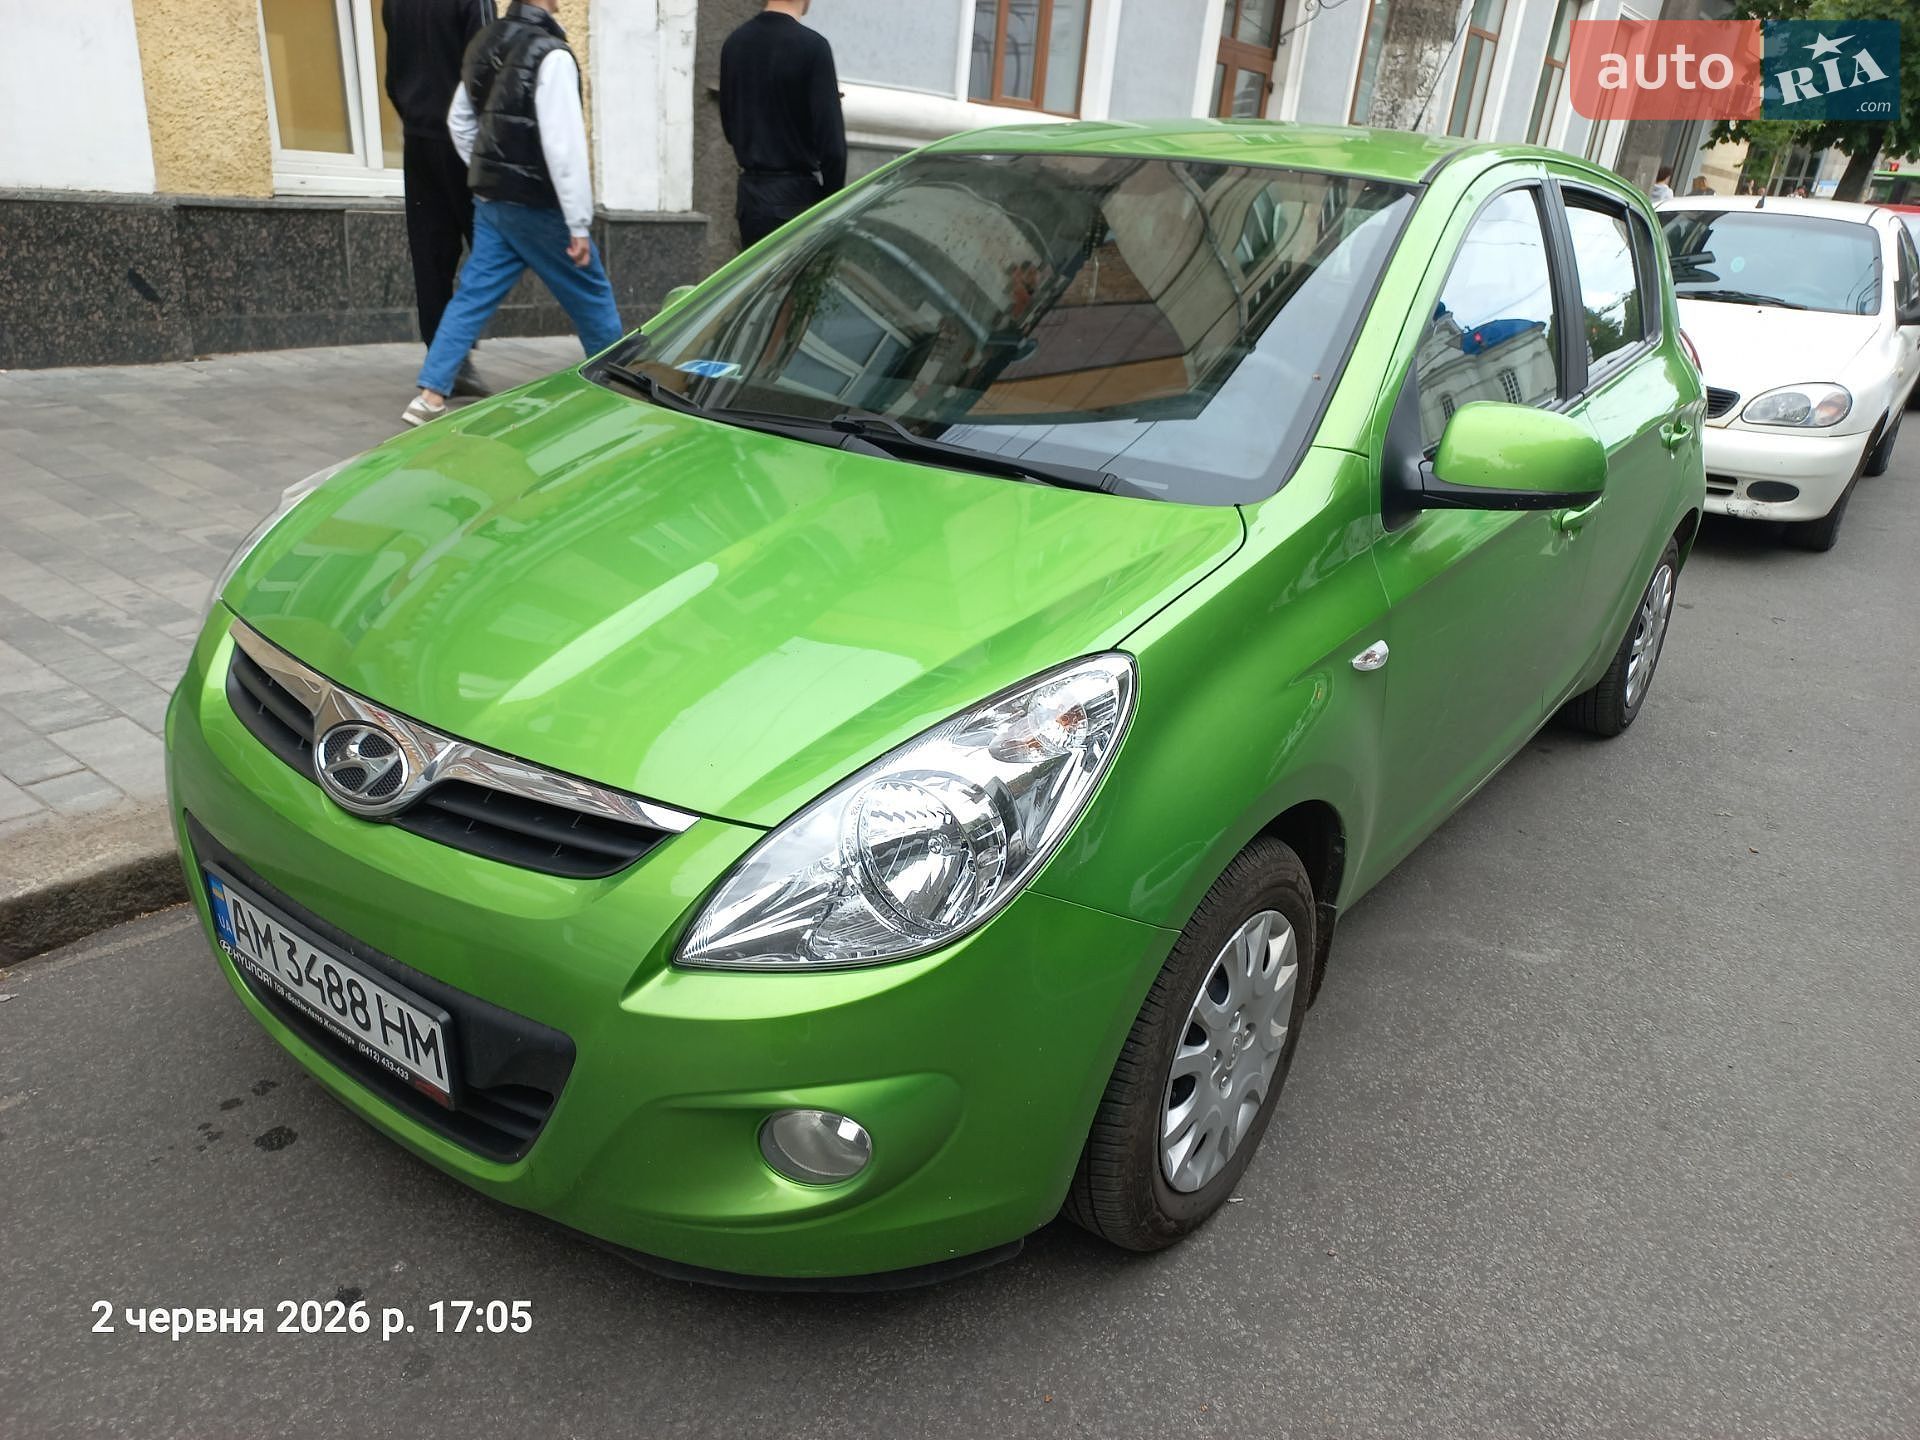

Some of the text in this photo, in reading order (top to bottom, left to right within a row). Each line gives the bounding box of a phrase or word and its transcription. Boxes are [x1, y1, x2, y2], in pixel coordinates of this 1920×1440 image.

[217, 913, 233, 935] UA
[233, 950, 273, 987] HYUNDAI
[358, 1042, 380, 1063] (0412)
[381, 1057, 409, 1081] 433-433
